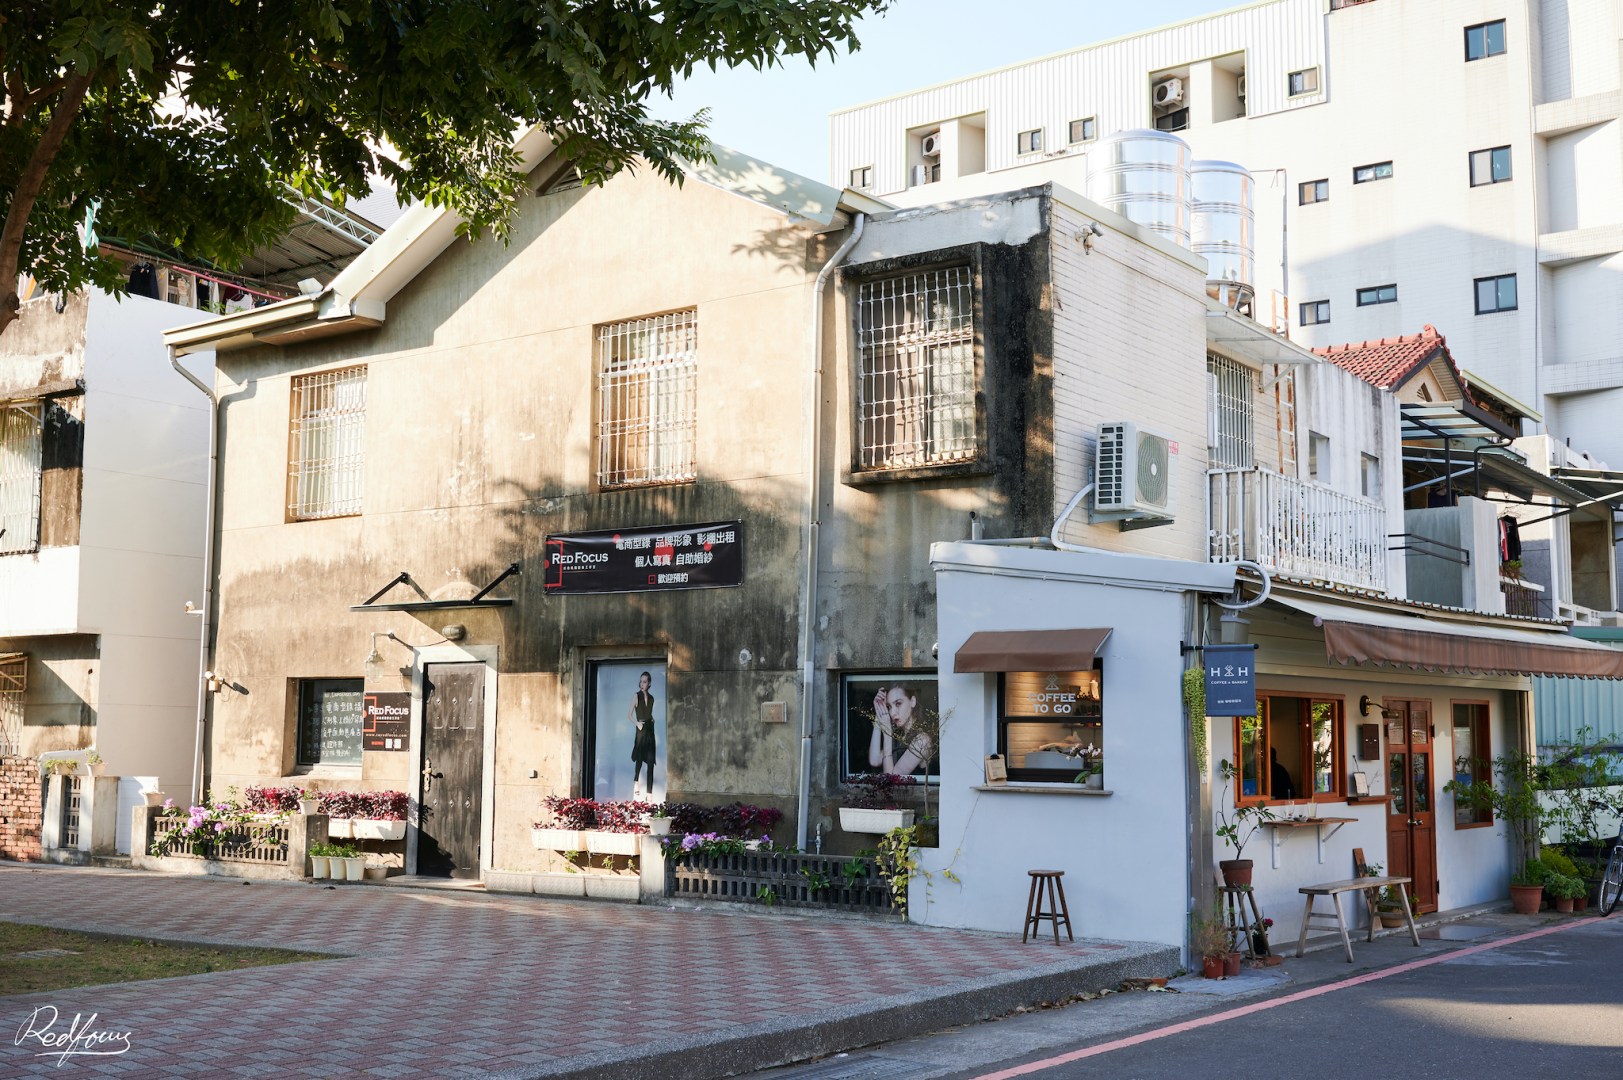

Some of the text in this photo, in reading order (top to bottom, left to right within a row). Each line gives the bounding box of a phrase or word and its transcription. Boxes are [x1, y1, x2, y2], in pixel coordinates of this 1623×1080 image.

[615, 531, 735, 550] 電商型錄 品牌形象 影棚出租
[635, 551, 713, 568] 個人寫真 自助婚紗
[657, 572, 689, 584] 歡迎預約
[1028, 693, 1076, 703] COFFEE
[1033, 704, 1072, 714] TO GO
